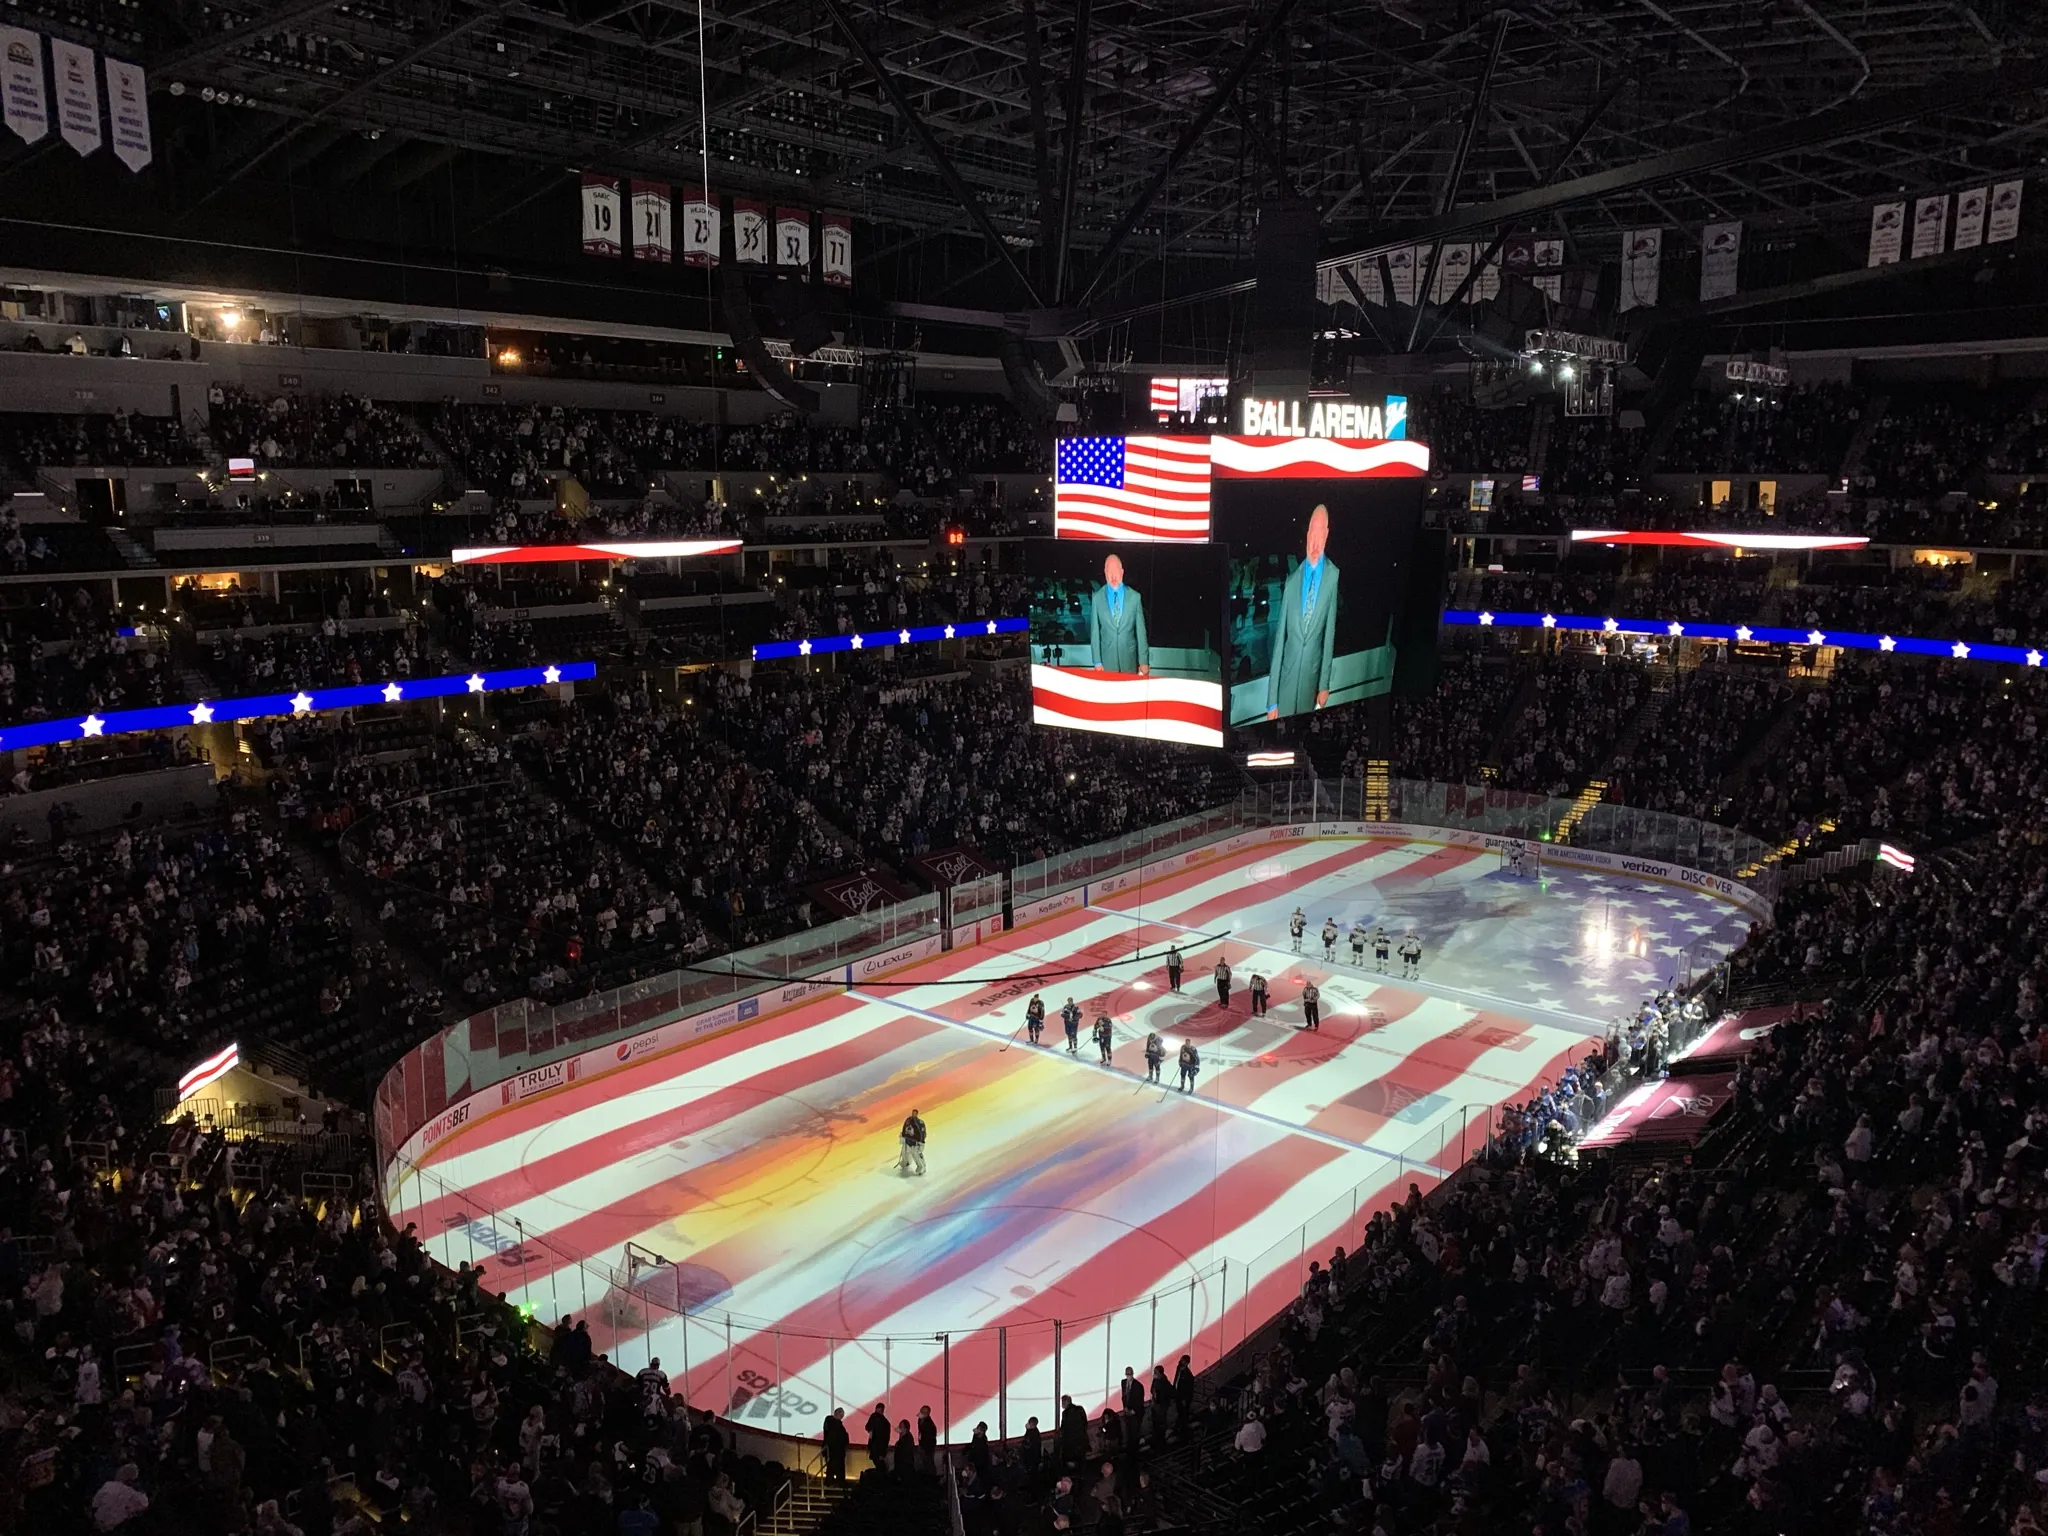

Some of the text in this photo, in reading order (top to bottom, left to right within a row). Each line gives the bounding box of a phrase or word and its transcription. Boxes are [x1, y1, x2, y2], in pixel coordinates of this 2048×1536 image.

[593, 192, 610, 200] SAKIC
[594, 204, 611, 231] 19
[645, 211, 659, 237] 21
[743, 227, 758, 251] 33
[787, 237, 800, 259] 52
[830, 241, 844, 265] 77
[1244, 397, 1384, 439] BALL ARENA
[1269, 827, 1306, 840] POINTSBET
[937, 854, 969, 878] Ball
[1622, 860, 1667, 877] verizon
[1681, 870, 1733, 896] DISCOVER
[840, 881, 874, 910] Ball
[1039, 900, 1063, 914] KeyBank
[876, 951, 913, 968] LEXUS
[972, 977, 1049, 1007] KeyBank
[696, 1009, 735, 1026] GRAB SUMMER
[704, 1022, 713, 1030] THE
[714, 1015, 736, 1026] COOLER
[632, 1033, 659, 1052] pepsi
[519, 1063, 562, 1088] TRULY
[422, 1103, 470, 1148] POINTSBET
[737, 1370, 818, 1415] adidas
